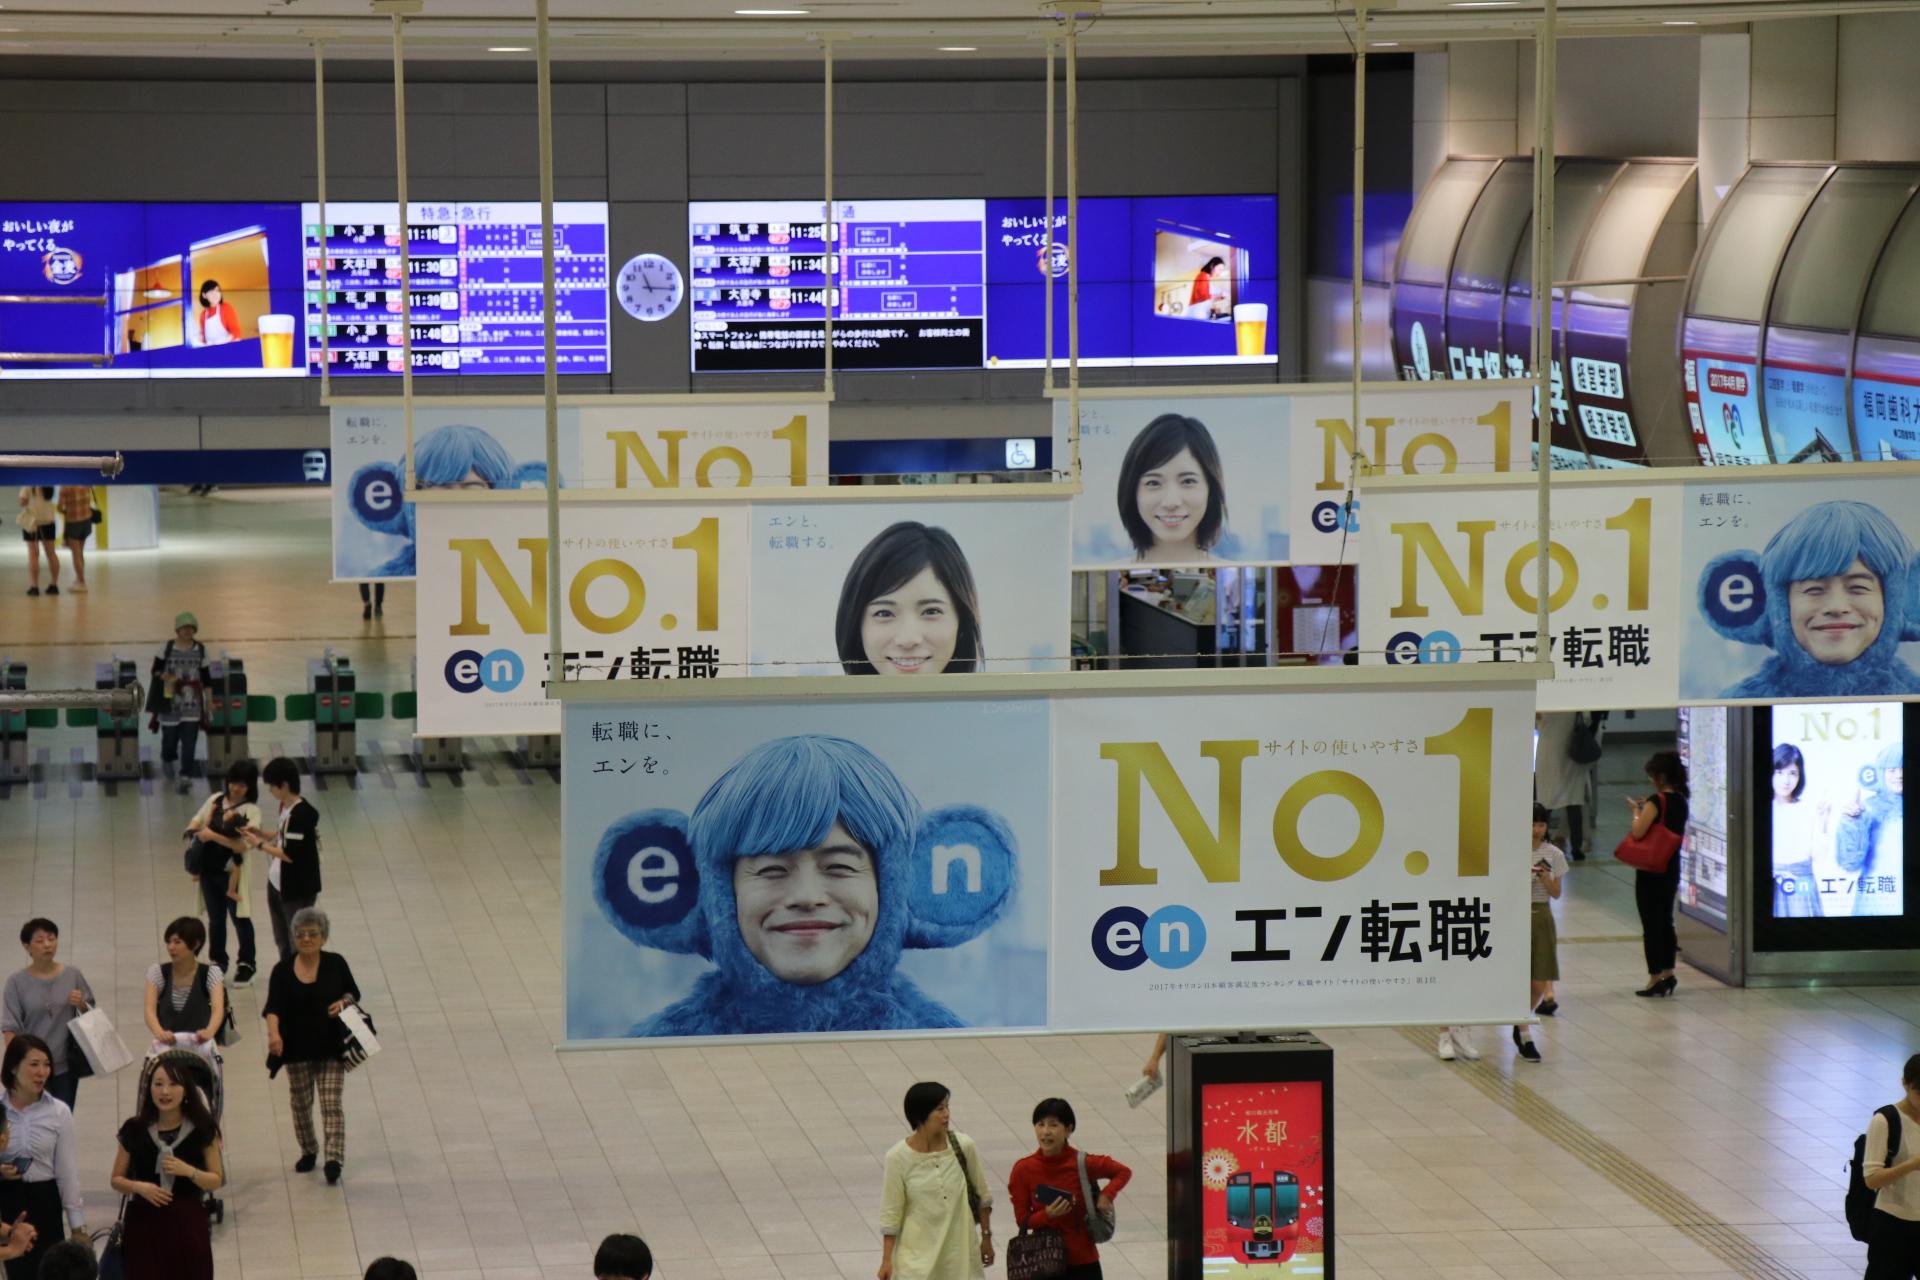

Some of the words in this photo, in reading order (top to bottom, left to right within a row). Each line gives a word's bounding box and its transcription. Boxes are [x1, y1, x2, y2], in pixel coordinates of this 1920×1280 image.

[2, 219, 74, 233] おいしい夜が
[562, 537, 669, 549] サイトの使いやすさ
[1390, 498, 1652, 618] No.1
[448, 517, 719, 636] No.1
[592, 721, 674, 742] 転職に、
[1265, 739, 1419, 756] サイトの使いやすさ
[592, 756, 671, 775] エンを。
[1100, 708, 1493, 886] No.1
[1821, 875, 1897, 894] エン転職
[1231, 897, 1493, 962] エン転職
[1237, 1119, 1288, 1147] 水都
